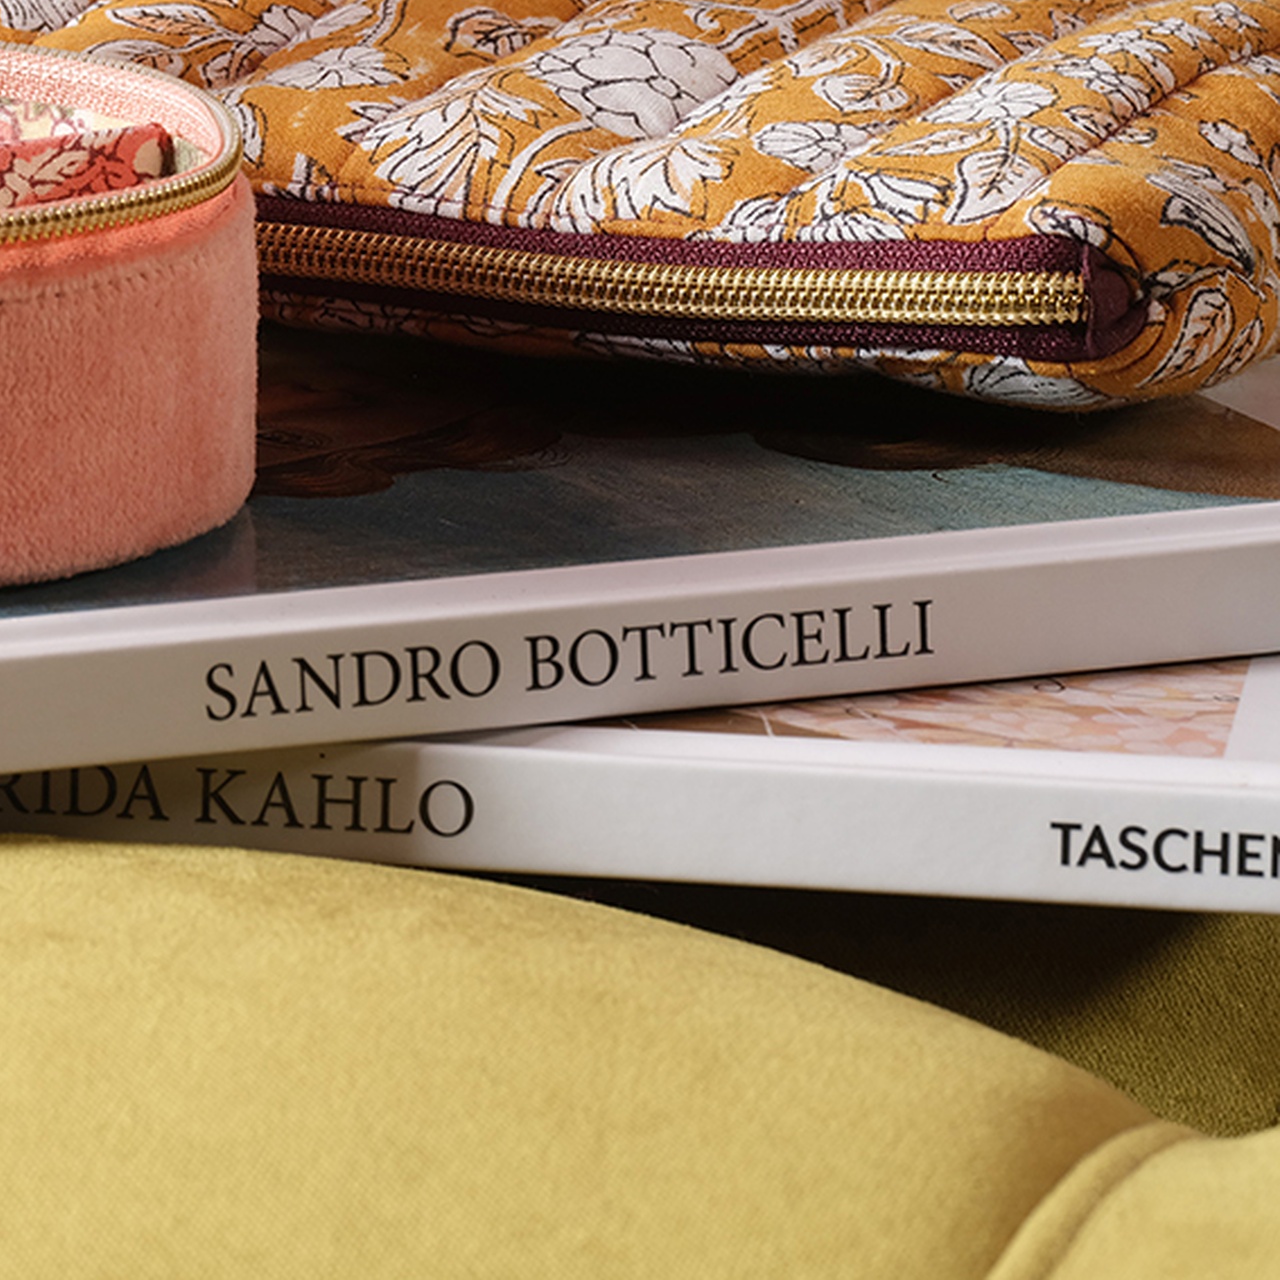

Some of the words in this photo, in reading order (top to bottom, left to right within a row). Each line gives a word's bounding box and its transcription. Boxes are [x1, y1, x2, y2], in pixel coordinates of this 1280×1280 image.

[205, 641, 500, 721] SANDRO
[524, 600, 934, 691] BOTTICELLI
[194, 767, 475, 837] KAHLO
[1050, 821, 1280, 878] TASCHE
